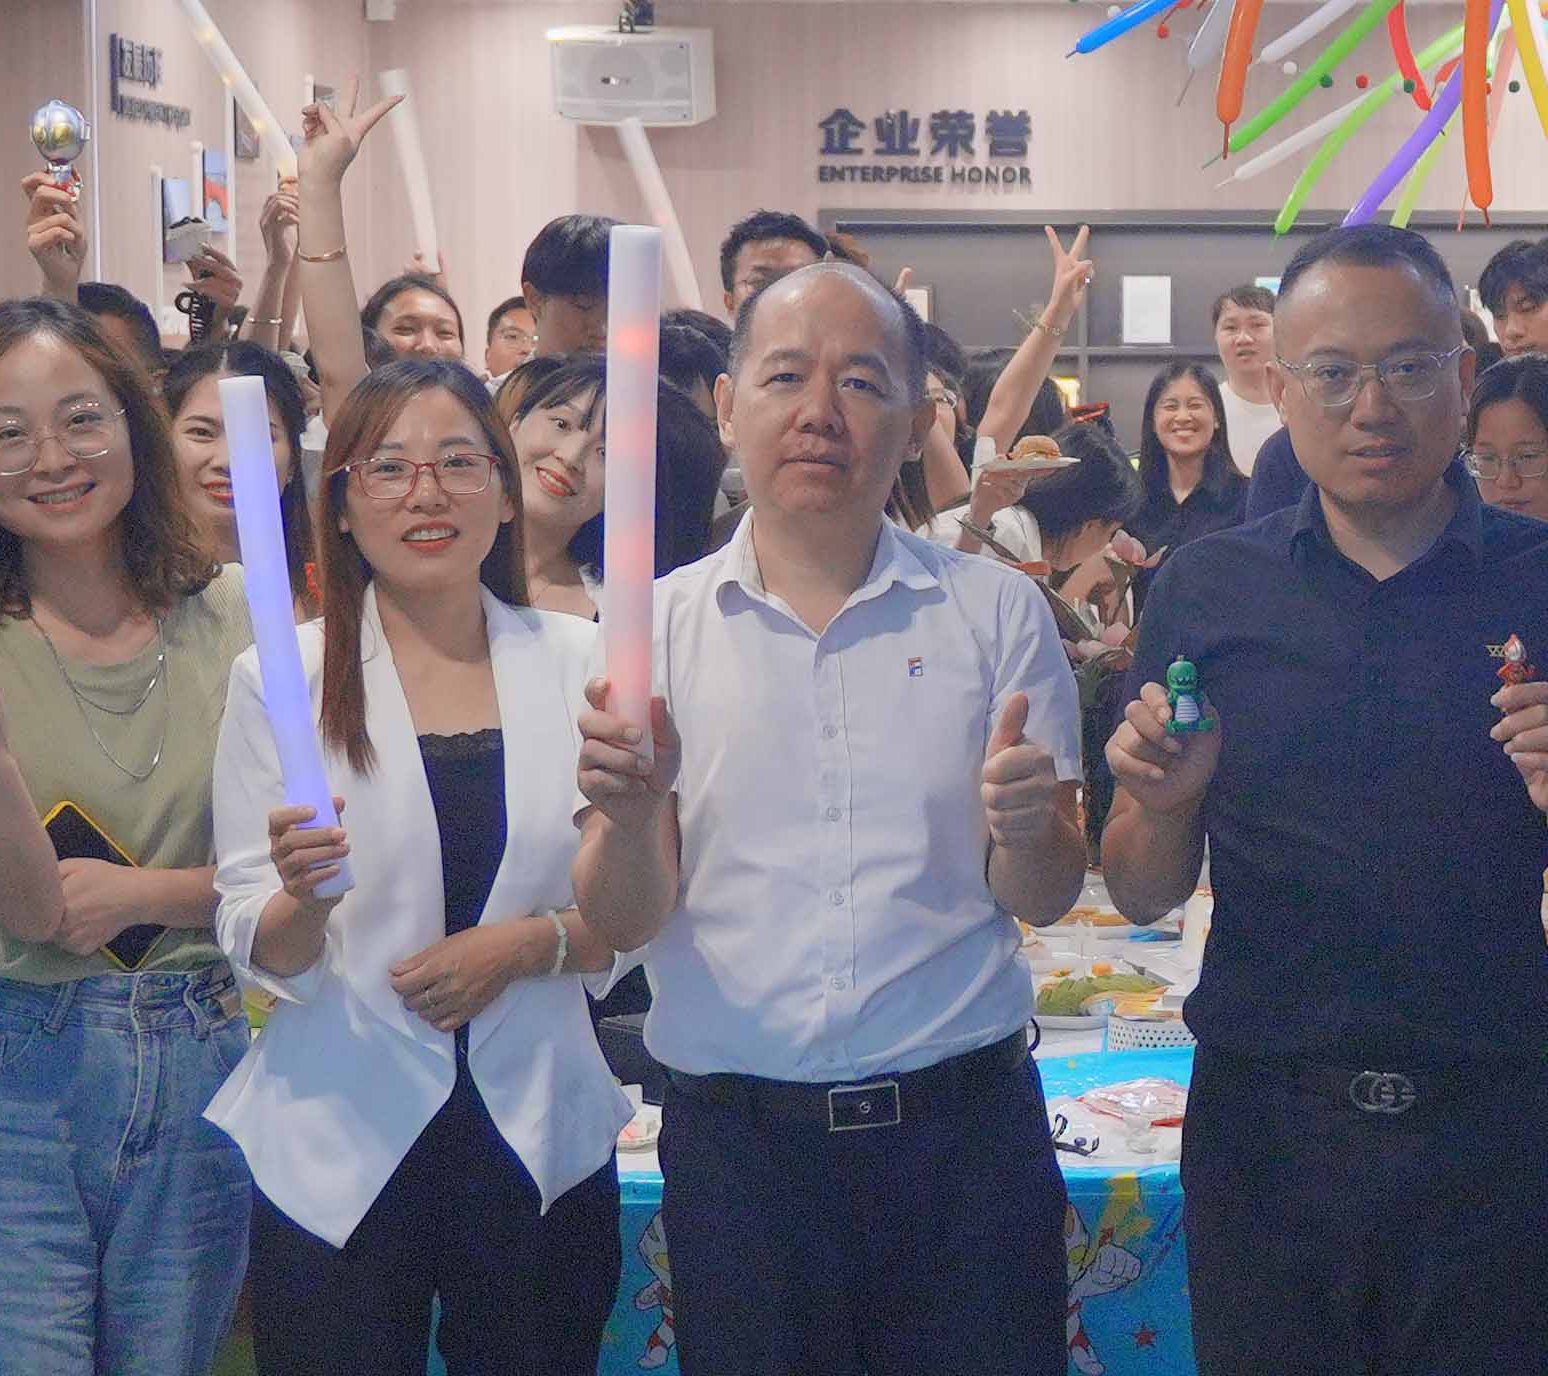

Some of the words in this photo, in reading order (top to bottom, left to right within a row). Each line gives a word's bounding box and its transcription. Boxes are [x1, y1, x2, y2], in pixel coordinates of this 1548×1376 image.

[818, 108, 1032, 158] 企业荣誉
[818, 165, 944, 184] ENTERPRISE
[951, 165, 1032, 186] HONOR
